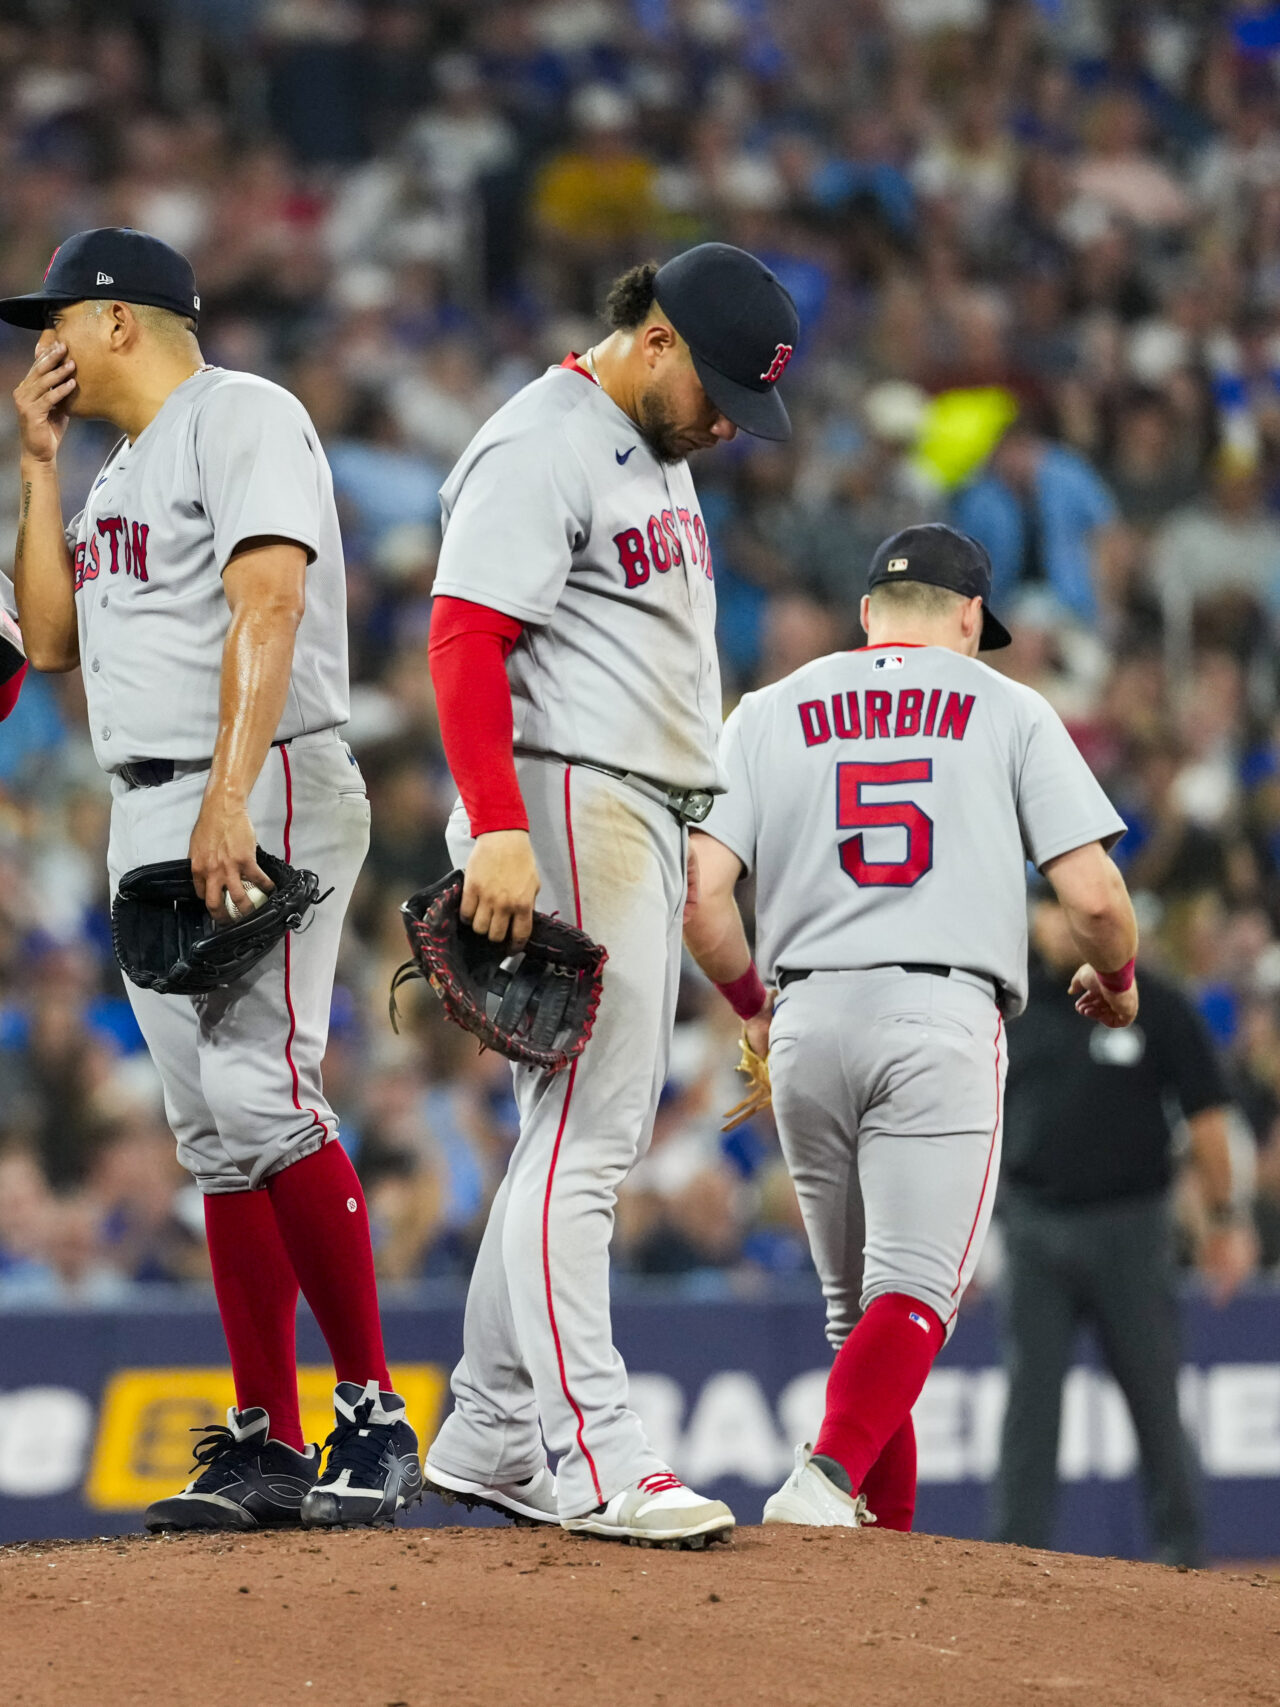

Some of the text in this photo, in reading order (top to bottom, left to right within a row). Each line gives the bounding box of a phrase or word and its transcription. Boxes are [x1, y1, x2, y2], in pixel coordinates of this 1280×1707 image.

[760, 343, 792, 382] B
[798, 688, 976, 748] DURBIN
[836, 757, 933, 888] 5
